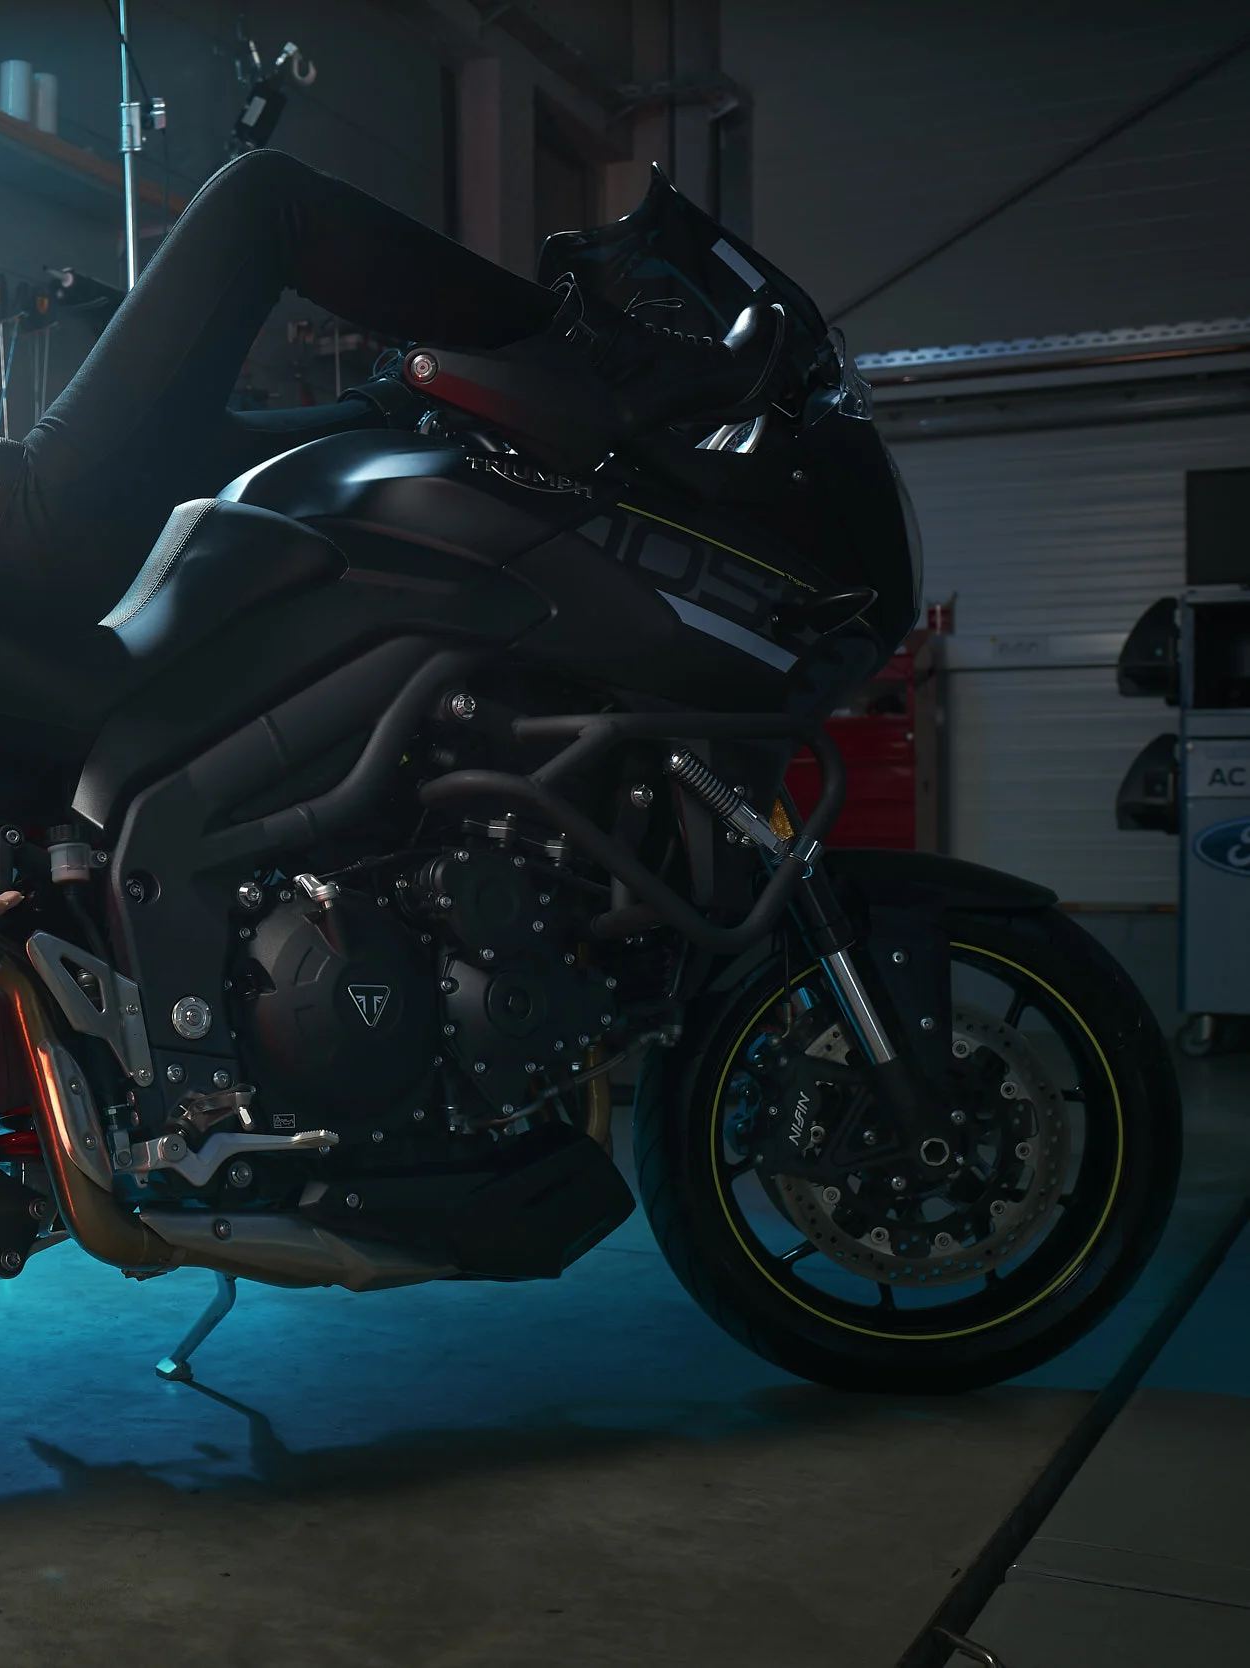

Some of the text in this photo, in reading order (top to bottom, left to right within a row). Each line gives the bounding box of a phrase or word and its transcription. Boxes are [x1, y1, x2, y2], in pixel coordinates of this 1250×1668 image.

[465, 456, 592, 499] TRIUMPH
[1208, 767, 1246, 787] AC
[788, 1090, 810, 1147] NISSIN
